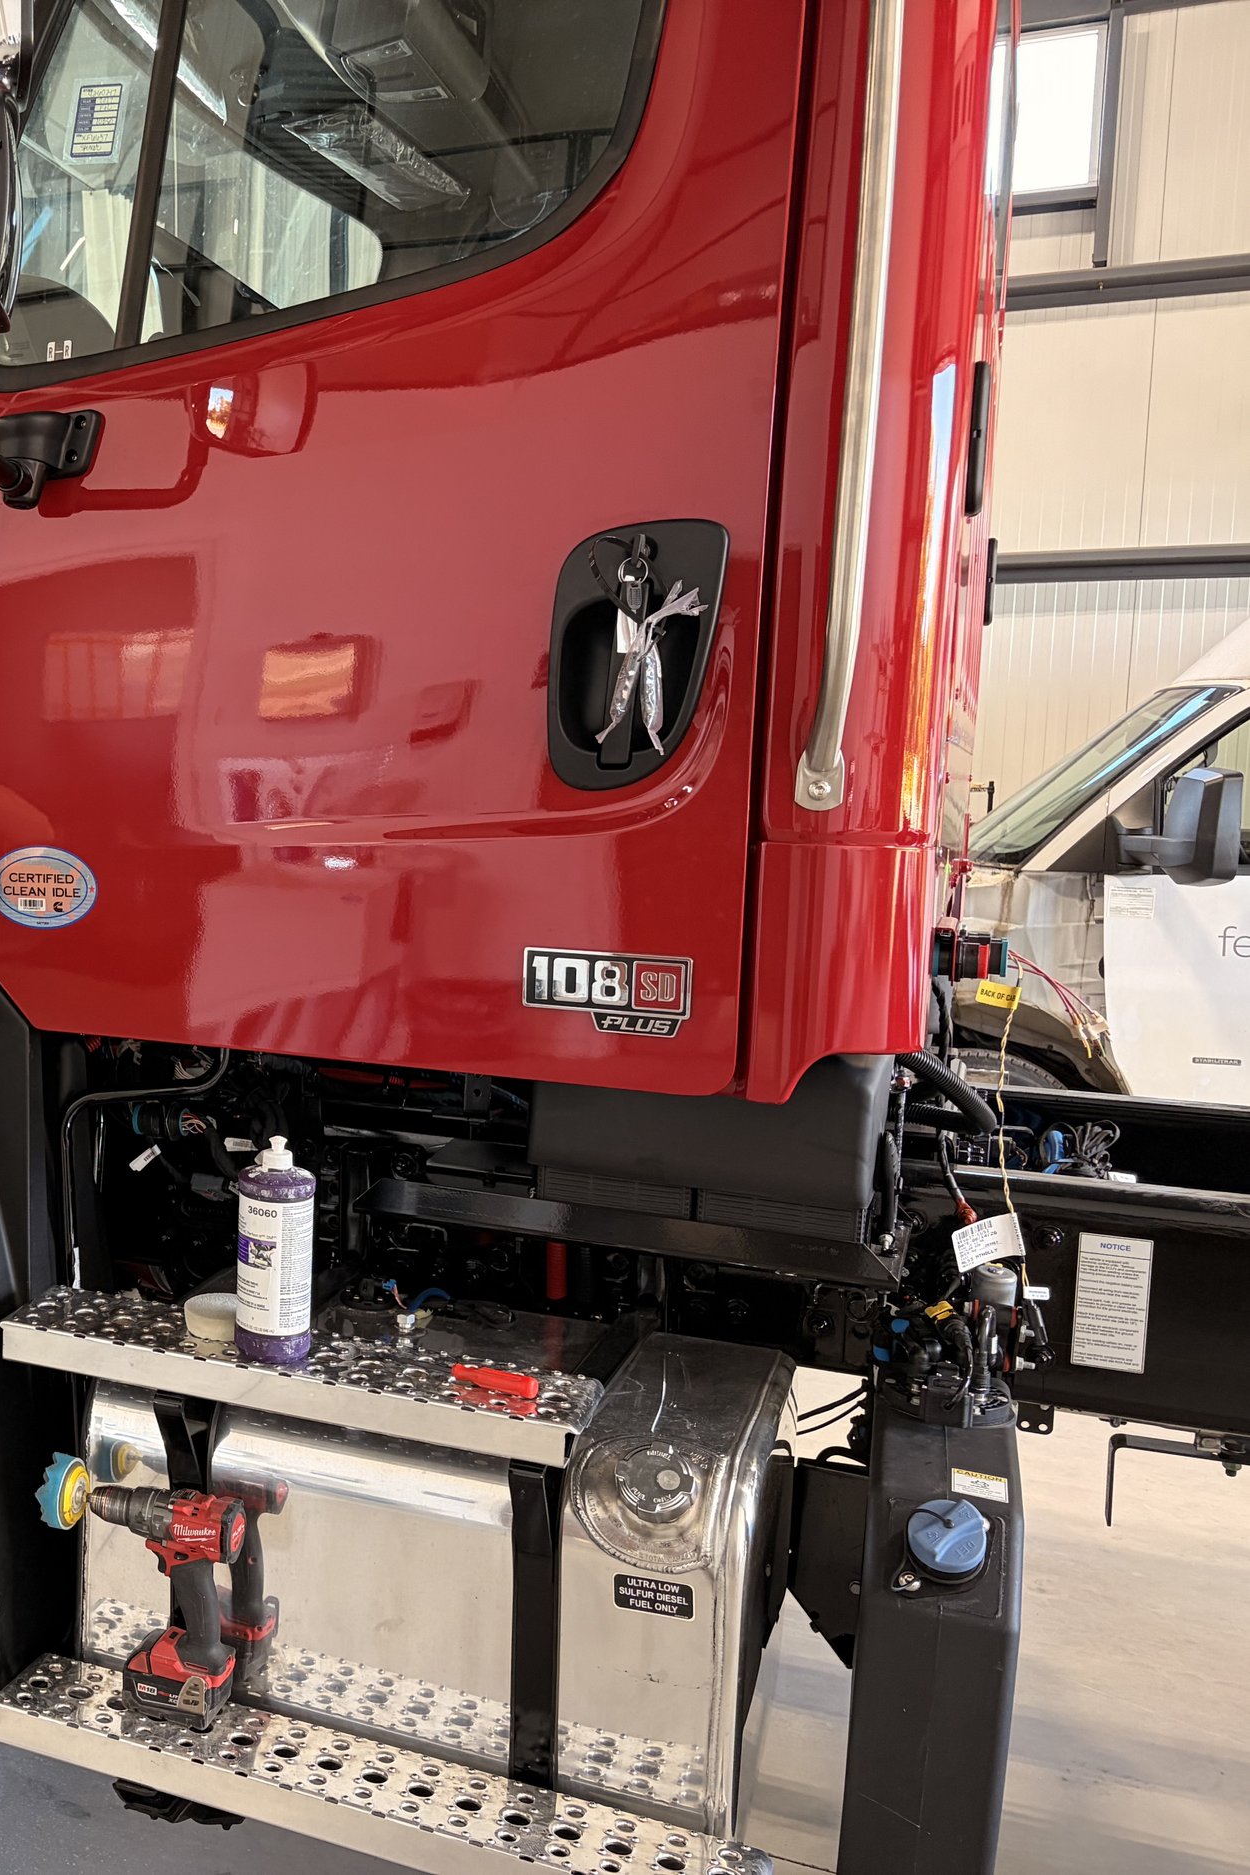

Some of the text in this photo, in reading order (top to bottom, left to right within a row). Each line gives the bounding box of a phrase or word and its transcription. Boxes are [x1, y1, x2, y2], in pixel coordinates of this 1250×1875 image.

[9, 872, 75, 885] CERTIFIED
[3, 885, 81, 898] CLEAN IDLE
[532, 955, 677, 1006] 108 SD
[980, 988, 996, 999] BACK
[996, 992, 1006, 1001] OF
[601, 1015, 672, 1034] PLUS
[248, 1205, 277, 1218] 36060
[1100, 1242, 1131, 1252] NOTICE
[956, 1470, 1002, 1482] CAUTION
[173, 1523, 216, 1537] Milwaukee
[627, 1577, 680, 1594] ULTRA LOW
[618, 1586, 689, 1606] SULFUR DIESEL
[629, 1598, 678, 1614] FUEL ONLY
[139, 1684, 156, 1694] M18
